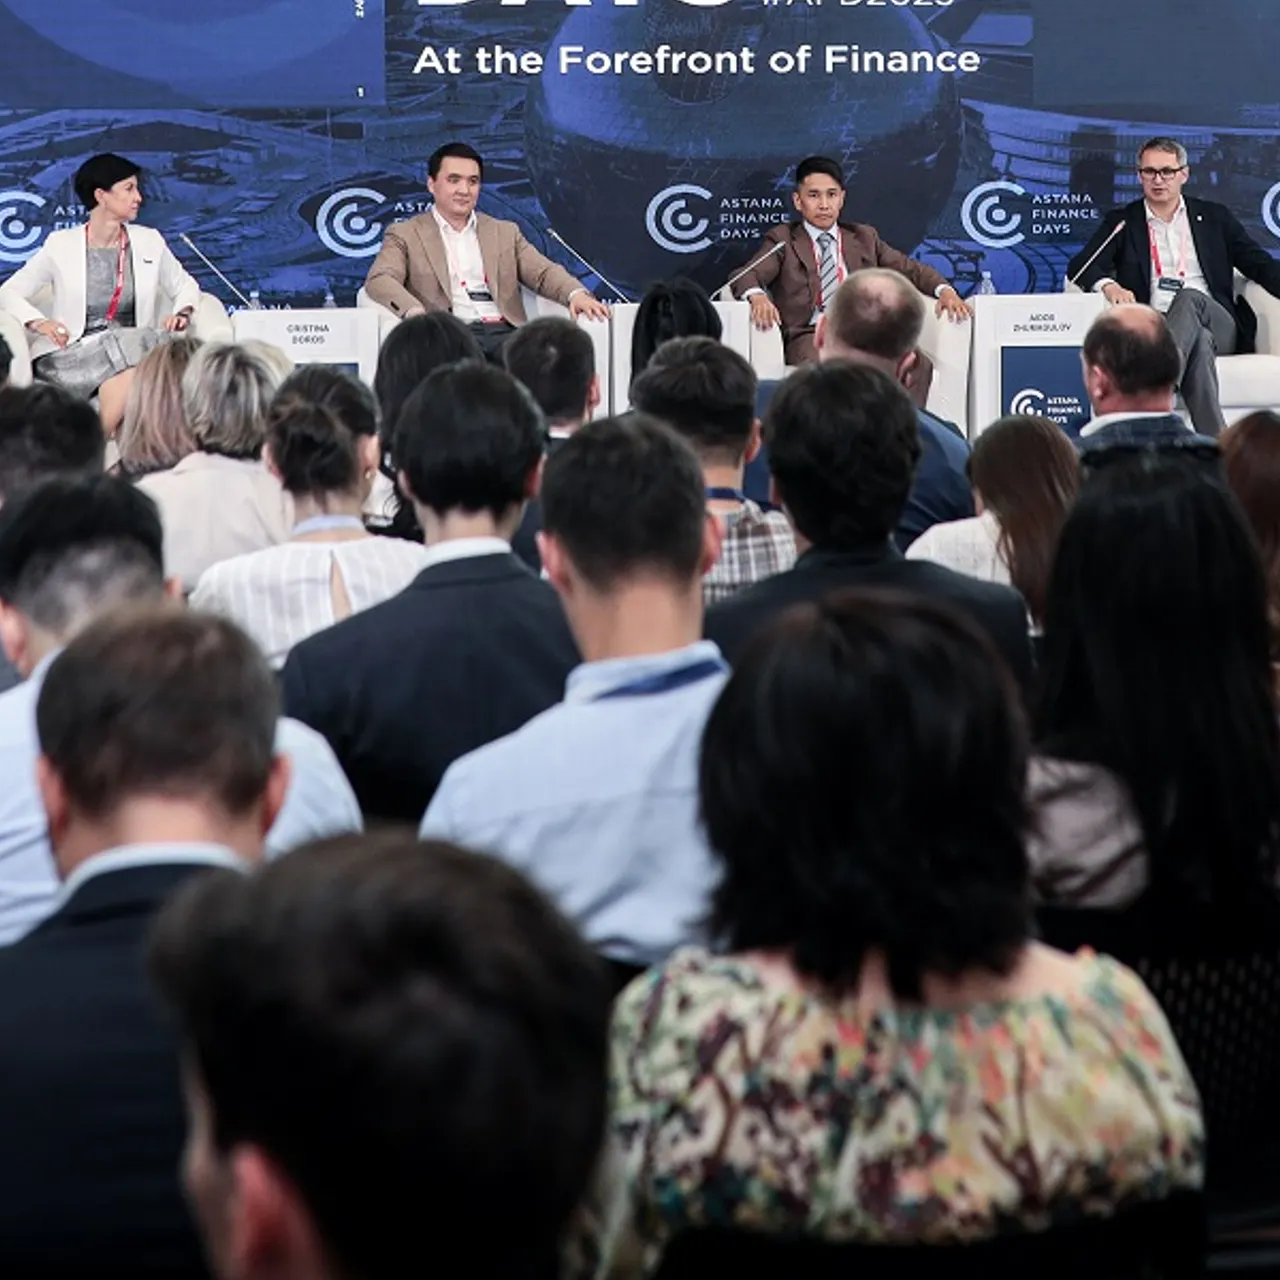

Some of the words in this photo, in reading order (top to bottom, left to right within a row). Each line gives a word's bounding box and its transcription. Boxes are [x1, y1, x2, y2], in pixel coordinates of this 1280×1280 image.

[412, 46, 462, 74] At
[475, 45, 544, 74] the
[558, 45, 756, 75] Forefront
[768, 45, 812, 75] of
[825, 45, 982, 74] Finance
[720, 198, 784, 208] ASTANA
[1032, 194, 1093, 204] ASTANA
[720, 213, 791, 224] FINANCE
[1032, 209, 1099, 219] FINANCE
[720, 228, 761, 238] DAYS
[1032, 224, 1071, 234] DAYS
